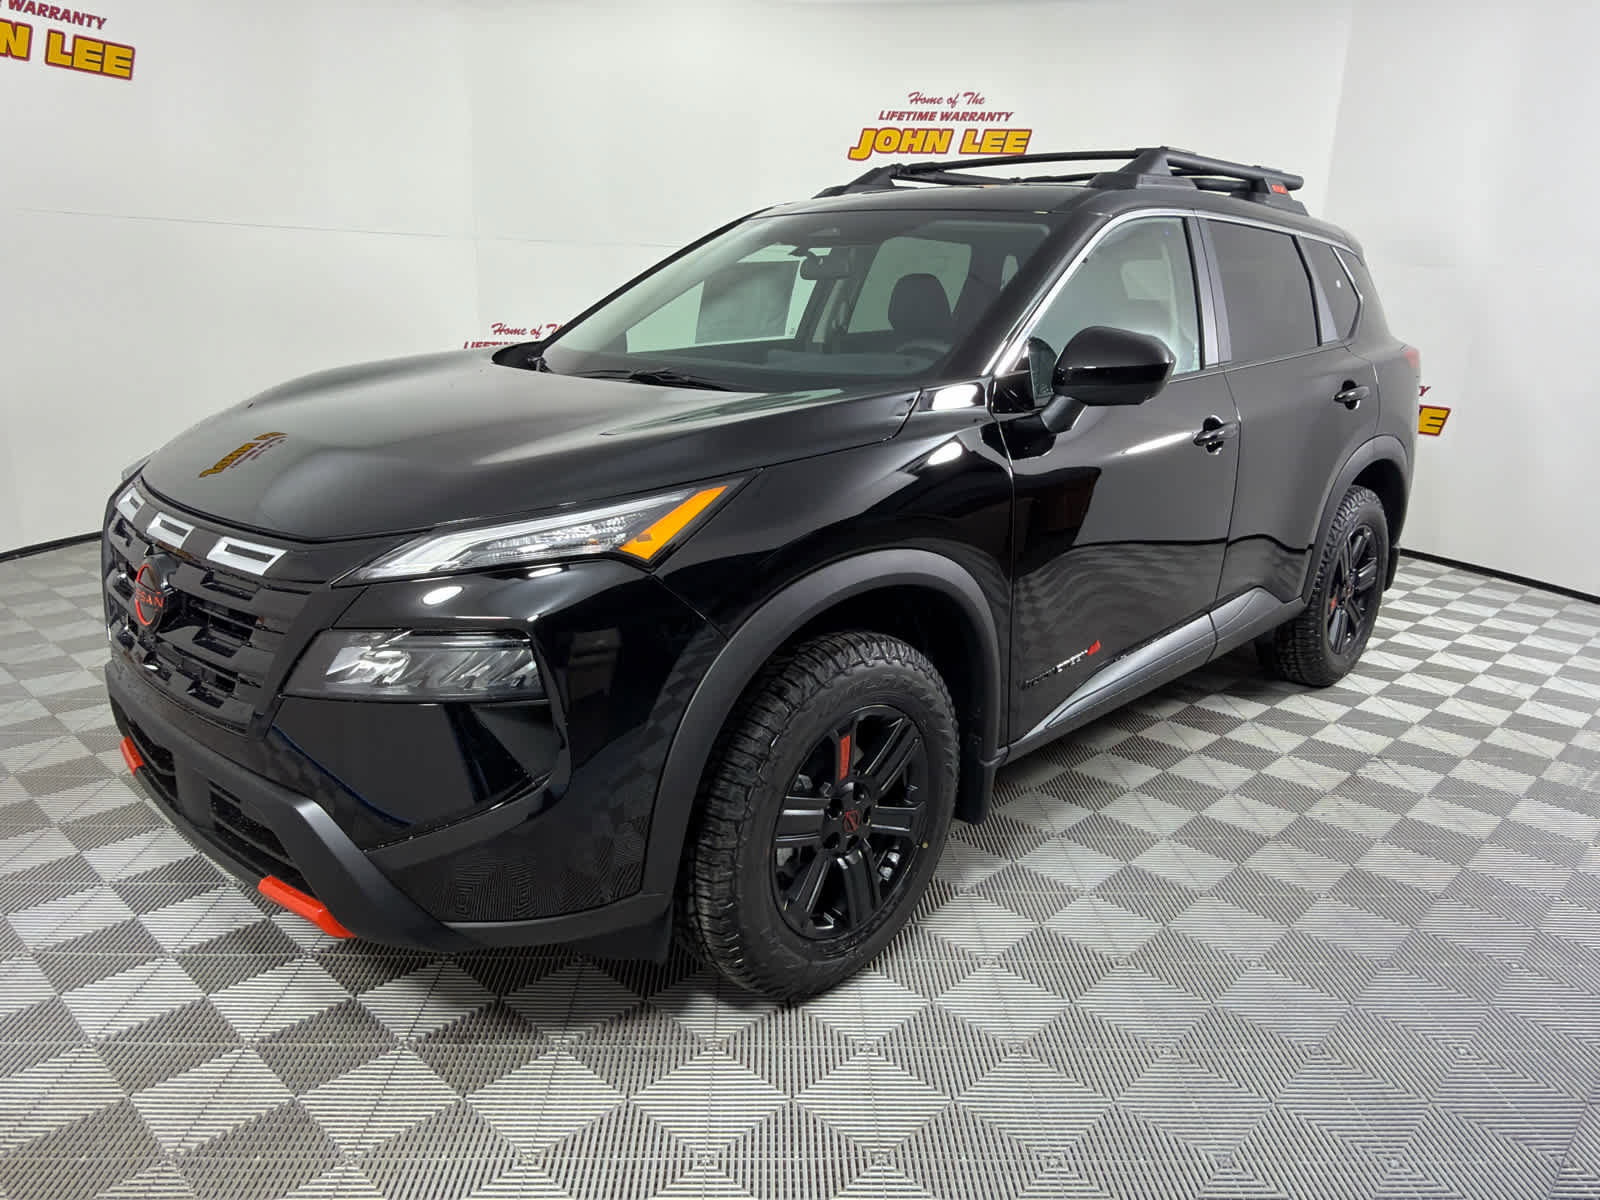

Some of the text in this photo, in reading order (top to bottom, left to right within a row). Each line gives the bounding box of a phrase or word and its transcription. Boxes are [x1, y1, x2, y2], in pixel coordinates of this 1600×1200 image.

[8, 0, 107, 30] WARRANTY
[45, 28, 136, 81] LEE
[908, 91, 985, 108] Home of The
[878, 111, 1014, 122] LIFETIME WARRANTY
[848, 127, 1032, 161] JOHN LEE
[491, 322, 527, 336] Home
[530, 325, 542, 339] of
